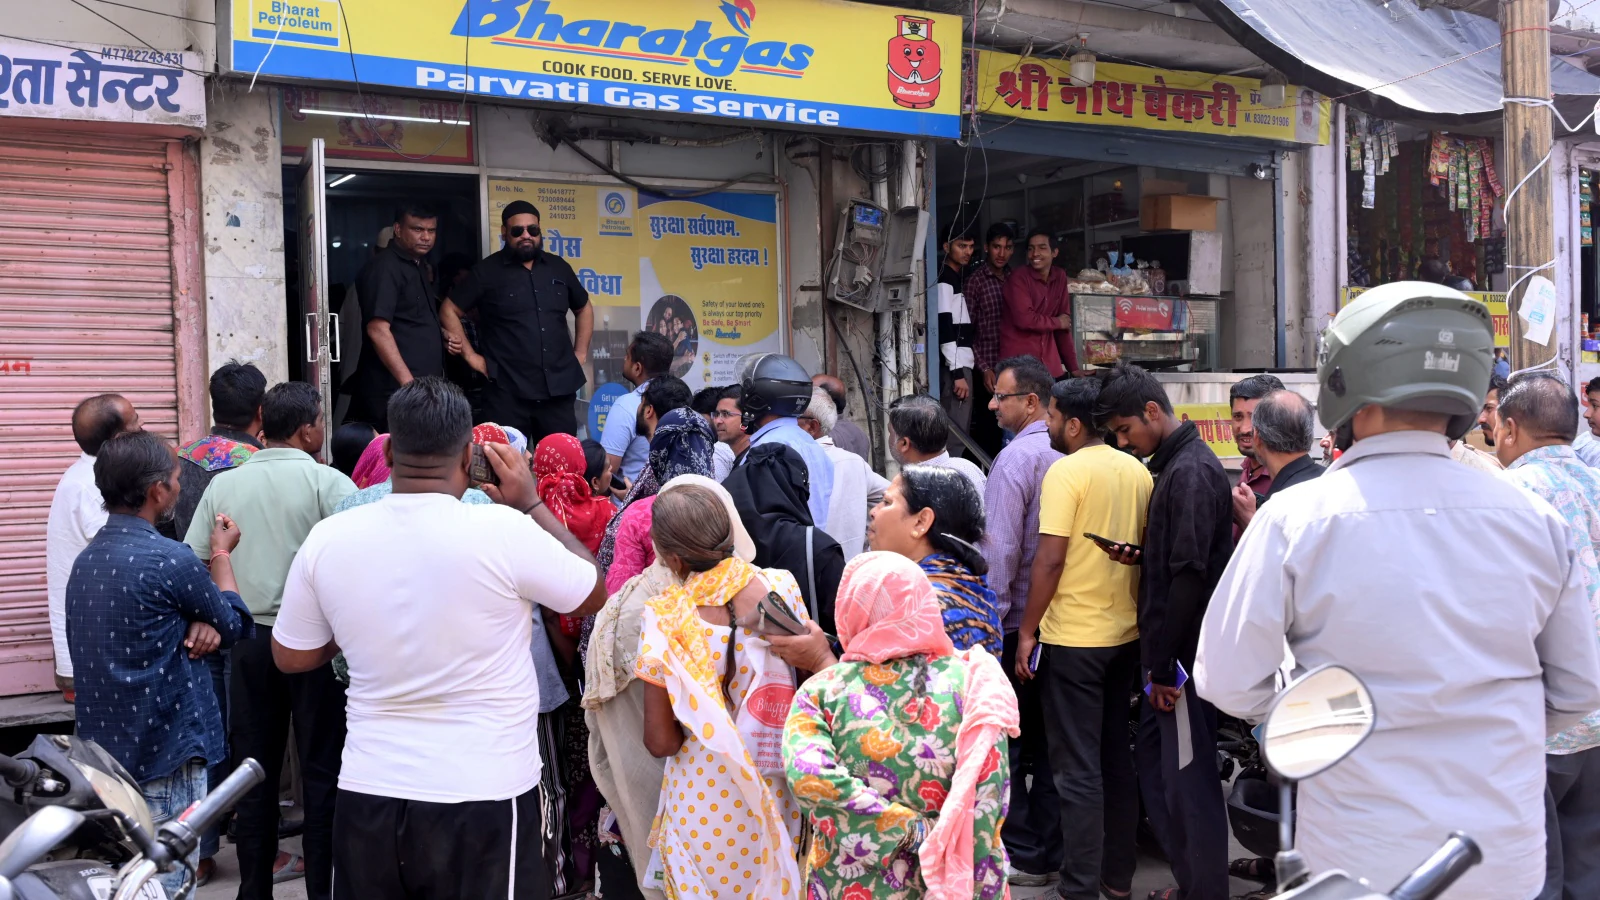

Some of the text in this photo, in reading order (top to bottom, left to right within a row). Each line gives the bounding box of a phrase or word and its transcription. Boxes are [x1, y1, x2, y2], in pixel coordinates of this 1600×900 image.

[258, 11, 332, 31] Petroleum
[272, 1, 320, 18] Bharat
[450, 0, 815, 77] Bharatgas
[66, 50, 184, 113] सेन्टर
[542, 60, 737, 91] COOK FOOD. SERVE LOVE.
[416, 66, 840, 126] Parvati Gas Service
[995, 63, 1053, 111] श्री
[1057, 76, 1137, 118] नाथ
[495, 185, 512, 193] Mob.
[649, 215, 686, 239] सुरक्षा
[547, 229, 583, 259] गैस
[690, 247, 726, 270] सुरक्षा
[727, 248, 760, 266] हरदम
[577, 268, 623, 296] विधा
[702, 300, 718, 309] Safety
[719, 300, 725, 308] of
[708, 310, 725, 318] always
[726, 319, 734, 327] Be
[734, 319, 751, 327] Smart
[601, 393, 611, 402] Get
